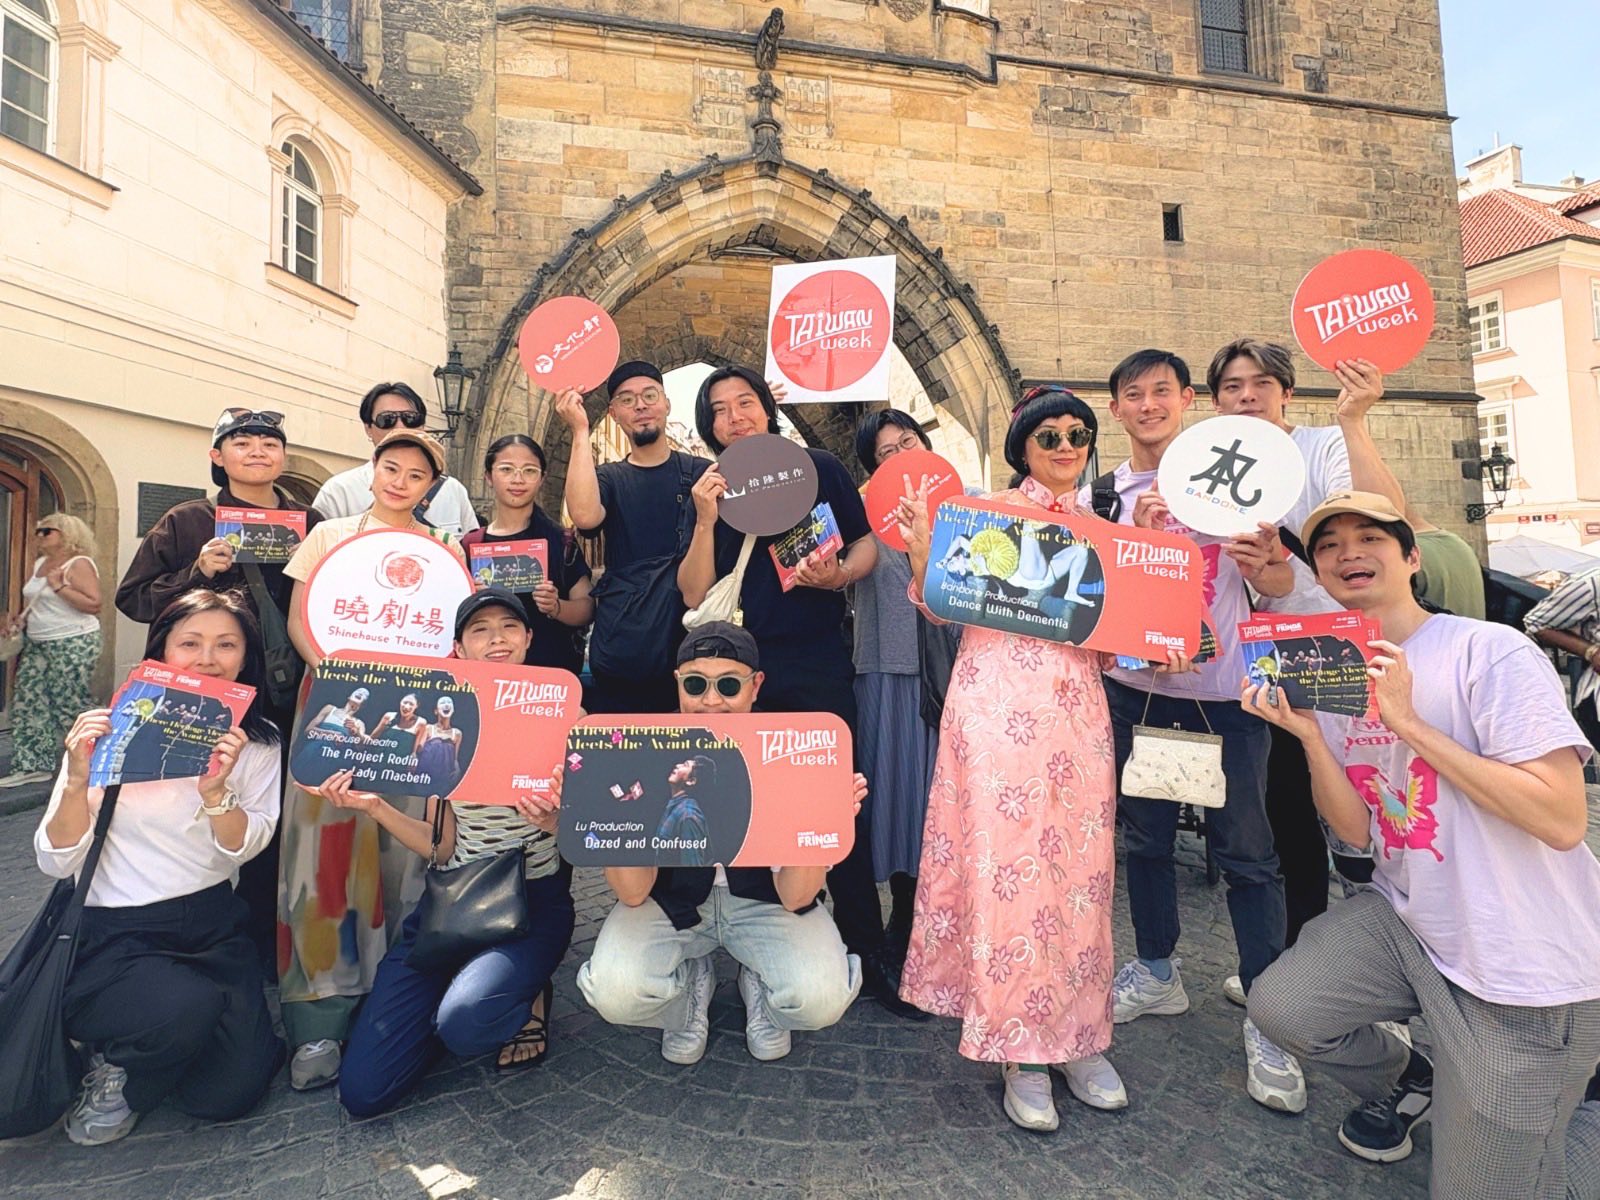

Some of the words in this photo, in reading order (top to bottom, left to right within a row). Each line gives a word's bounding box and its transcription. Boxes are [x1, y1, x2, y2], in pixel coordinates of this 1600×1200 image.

[1356, 305, 1418, 334] week
[820, 329, 872, 350] week
[1185, 487, 1248, 515] BANDONE
[1143, 564, 1188, 581] week
[985, 591, 1038, 609] Productions
[333, 595, 444, 636] 曉劇場
[948, 596, 982, 611] Dance
[986, 603, 1014, 618] With
[1017, 610, 1069, 630] Dementia
[328, 626, 390, 644] Shinehouse
[395, 635, 440, 650] Theatre
[314, 668, 359, 682] Meets
[363, 673, 387, 685] the
[394, 675, 432, 689] Avant
[520, 703, 565, 718] week
[307, 730, 360, 745] Shinehouse
[567, 738, 613, 750] Meets
[619, 738, 643, 750] the
[651, 738, 691, 750] Avant
[321, 746, 340, 759] The
[344, 750, 383, 764] Project
[387, 752, 419, 767] Rodin
[790, 748, 838, 765] week
[352, 766, 377, 782] Lady
[381, 769, 432, 785] Macbeth
[575, 821, 588, 832] Lu
[589, 821, 644, 832] Production
[585, 836, 621, 849] Dazed
[625, 837, 646, 849] and
[651, 837, 707, 849] Confused
